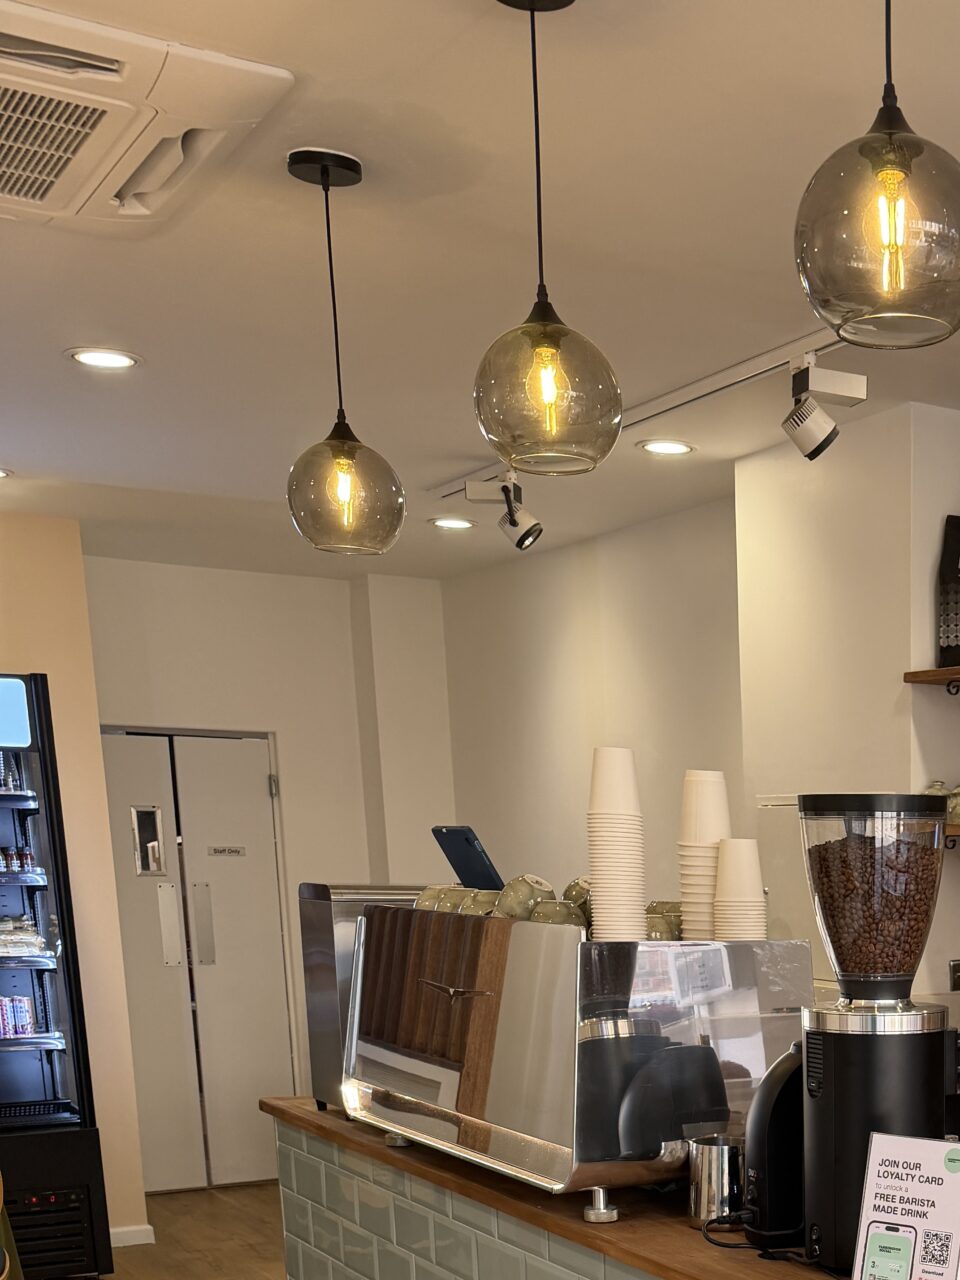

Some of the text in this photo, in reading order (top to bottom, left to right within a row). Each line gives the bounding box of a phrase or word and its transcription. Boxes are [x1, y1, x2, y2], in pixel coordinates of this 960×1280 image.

[878, 1158, 922, 1171] JOIN OUR
[877, 1170, 944, 1186] LOYALTY CARD
[883, 1184, 903, 1192] unlock
[874, 1192, 936, 1208] FREE BARISTA
[872, 1204, 929, 1219] MADE DRINK
